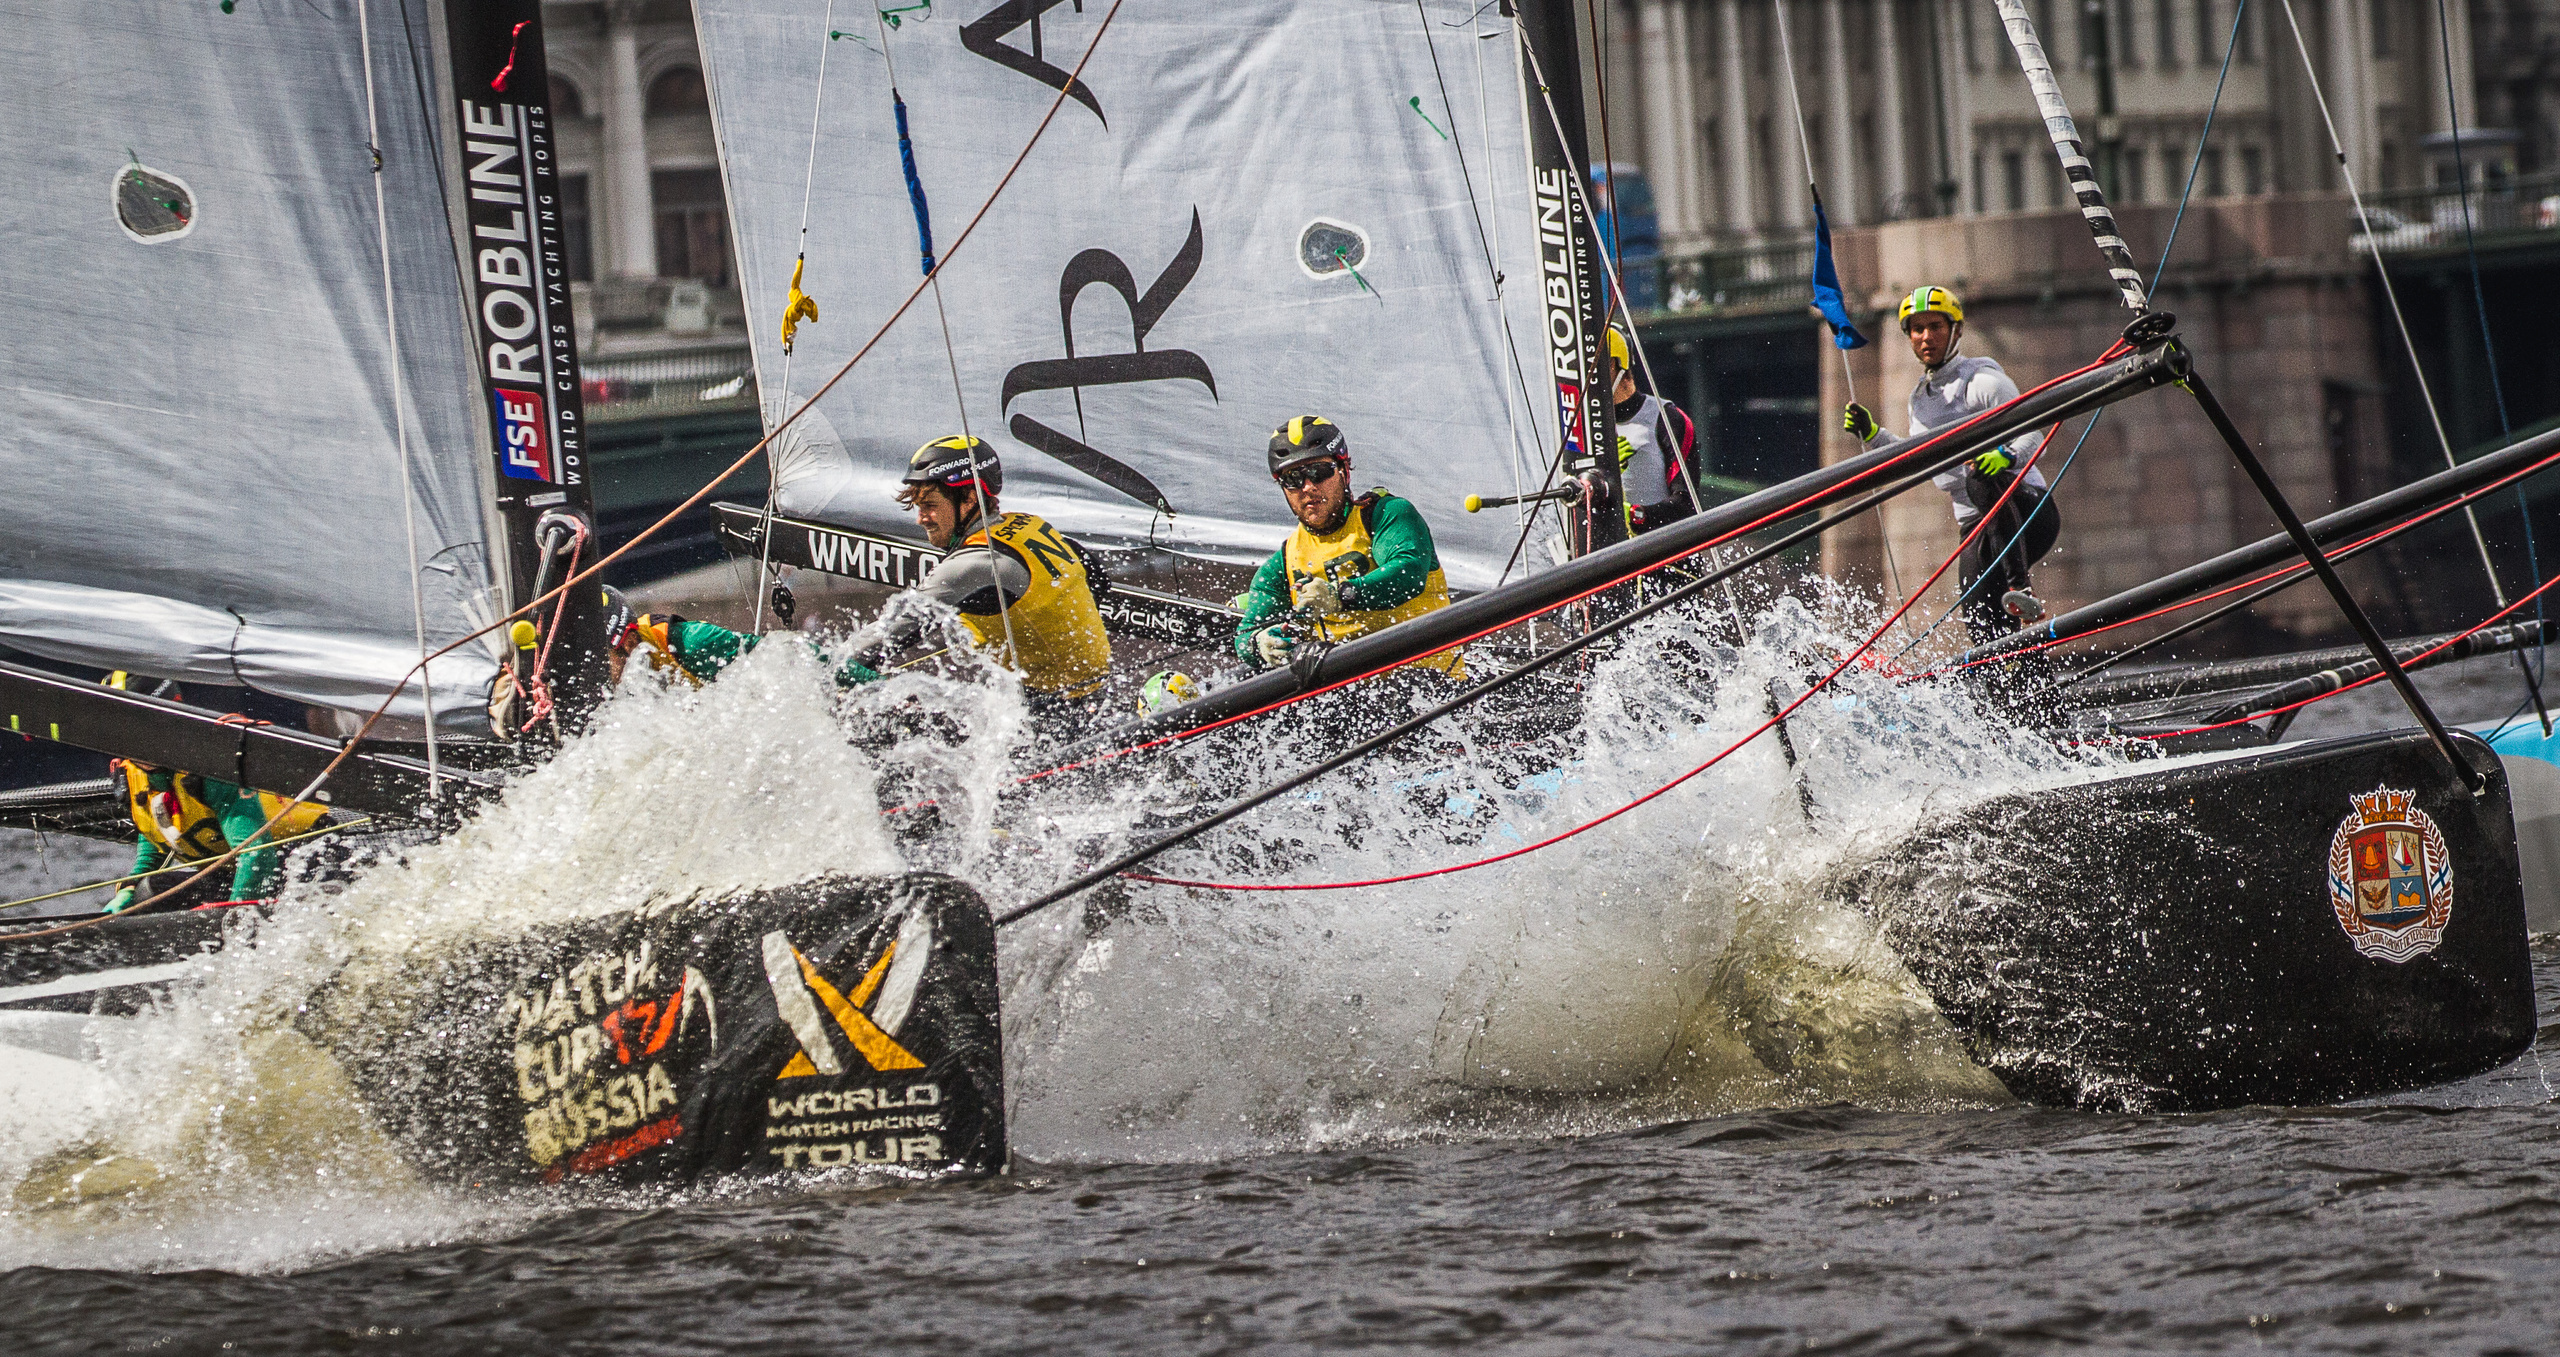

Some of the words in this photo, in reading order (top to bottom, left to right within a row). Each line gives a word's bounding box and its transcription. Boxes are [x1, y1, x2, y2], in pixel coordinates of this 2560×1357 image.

[529, 105, 550, 176] ROPES
[462, 99, 543, 384] ROBLINE
[540, 194, 564, 305] YACHTING
[1534, 165, 1579, 380] ROBLINE
[1575, 236, 1593, 322] YACHTING
[552, 324, 573, 391] CLASS
[504, 400, 541, 468] FSE
[561, 410, 582, 486] WORLD
[1560, 390, 1580, 443] FSE
[1590, 399, 1605, 456] WORLD
[928, 456, 971, 477] FORWARD
[1099, 603, 1188, 634] RACING
[514, 1024, 602, 1102] CUP
[765, 1121, 851, 1139] MATCH
[852, 1112, 943, 1134] RACING
[767, 1083, 943, 1119] WORLD
[768, 1133, 944, 1169] TOUR
